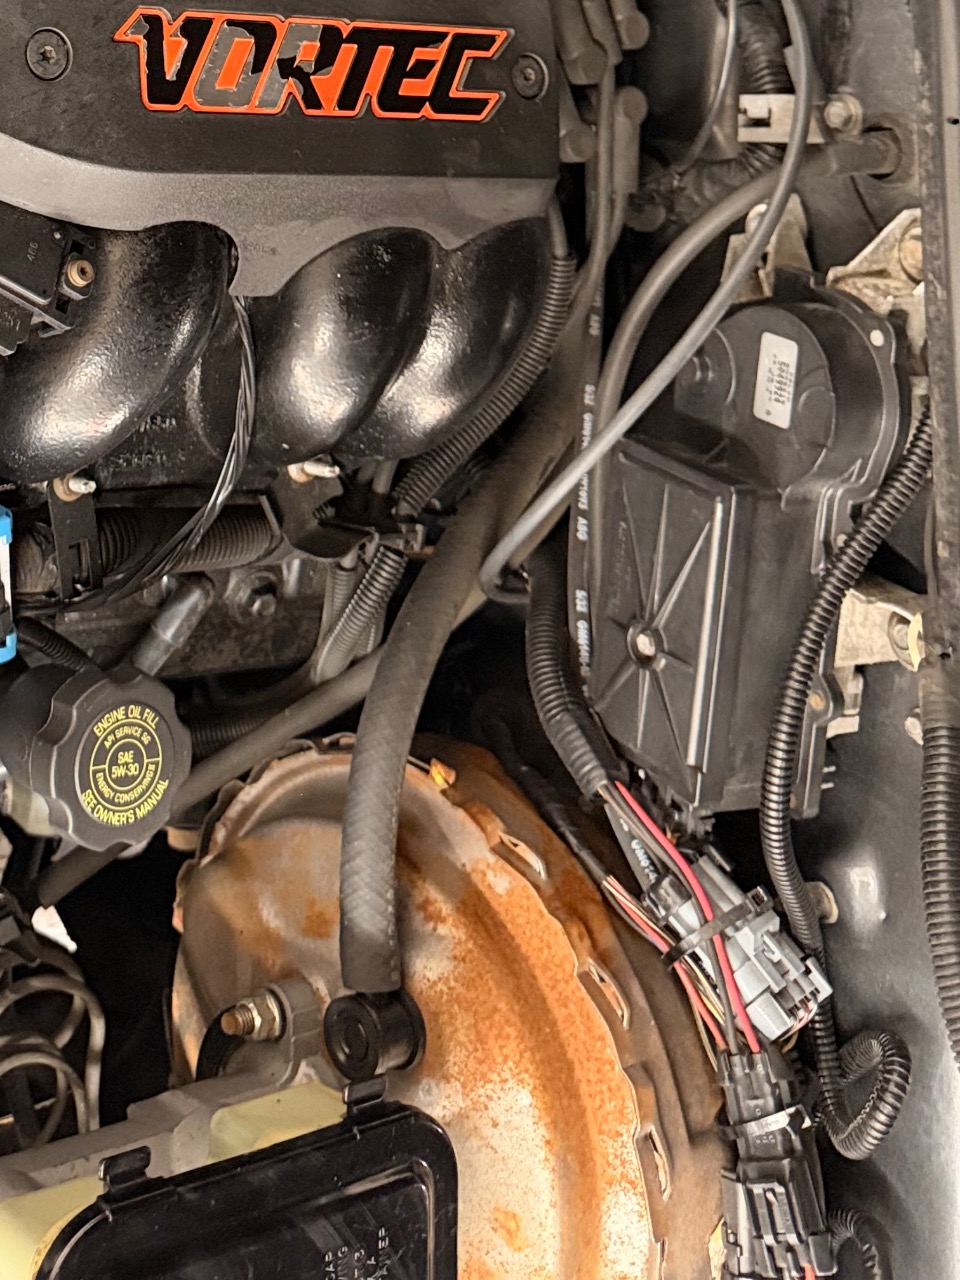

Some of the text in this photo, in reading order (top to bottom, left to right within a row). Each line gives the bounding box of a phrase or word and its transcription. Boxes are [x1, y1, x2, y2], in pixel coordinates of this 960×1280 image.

[114, 5, 508, 121] VORTEC
[93, 704, 160, 737] ENGINE OIL FILL
[104, 726, 152, 749] API SERVICE SG
[112, 763, 139, 778] 5W-30
[118, 750, 134, 764] SAE
[82, 779, 169, 826] SEE OWNER'S MANUAL
[96, 772, 116, 800] ENERGY
[114, 771, 155, 804] CONSERVING
